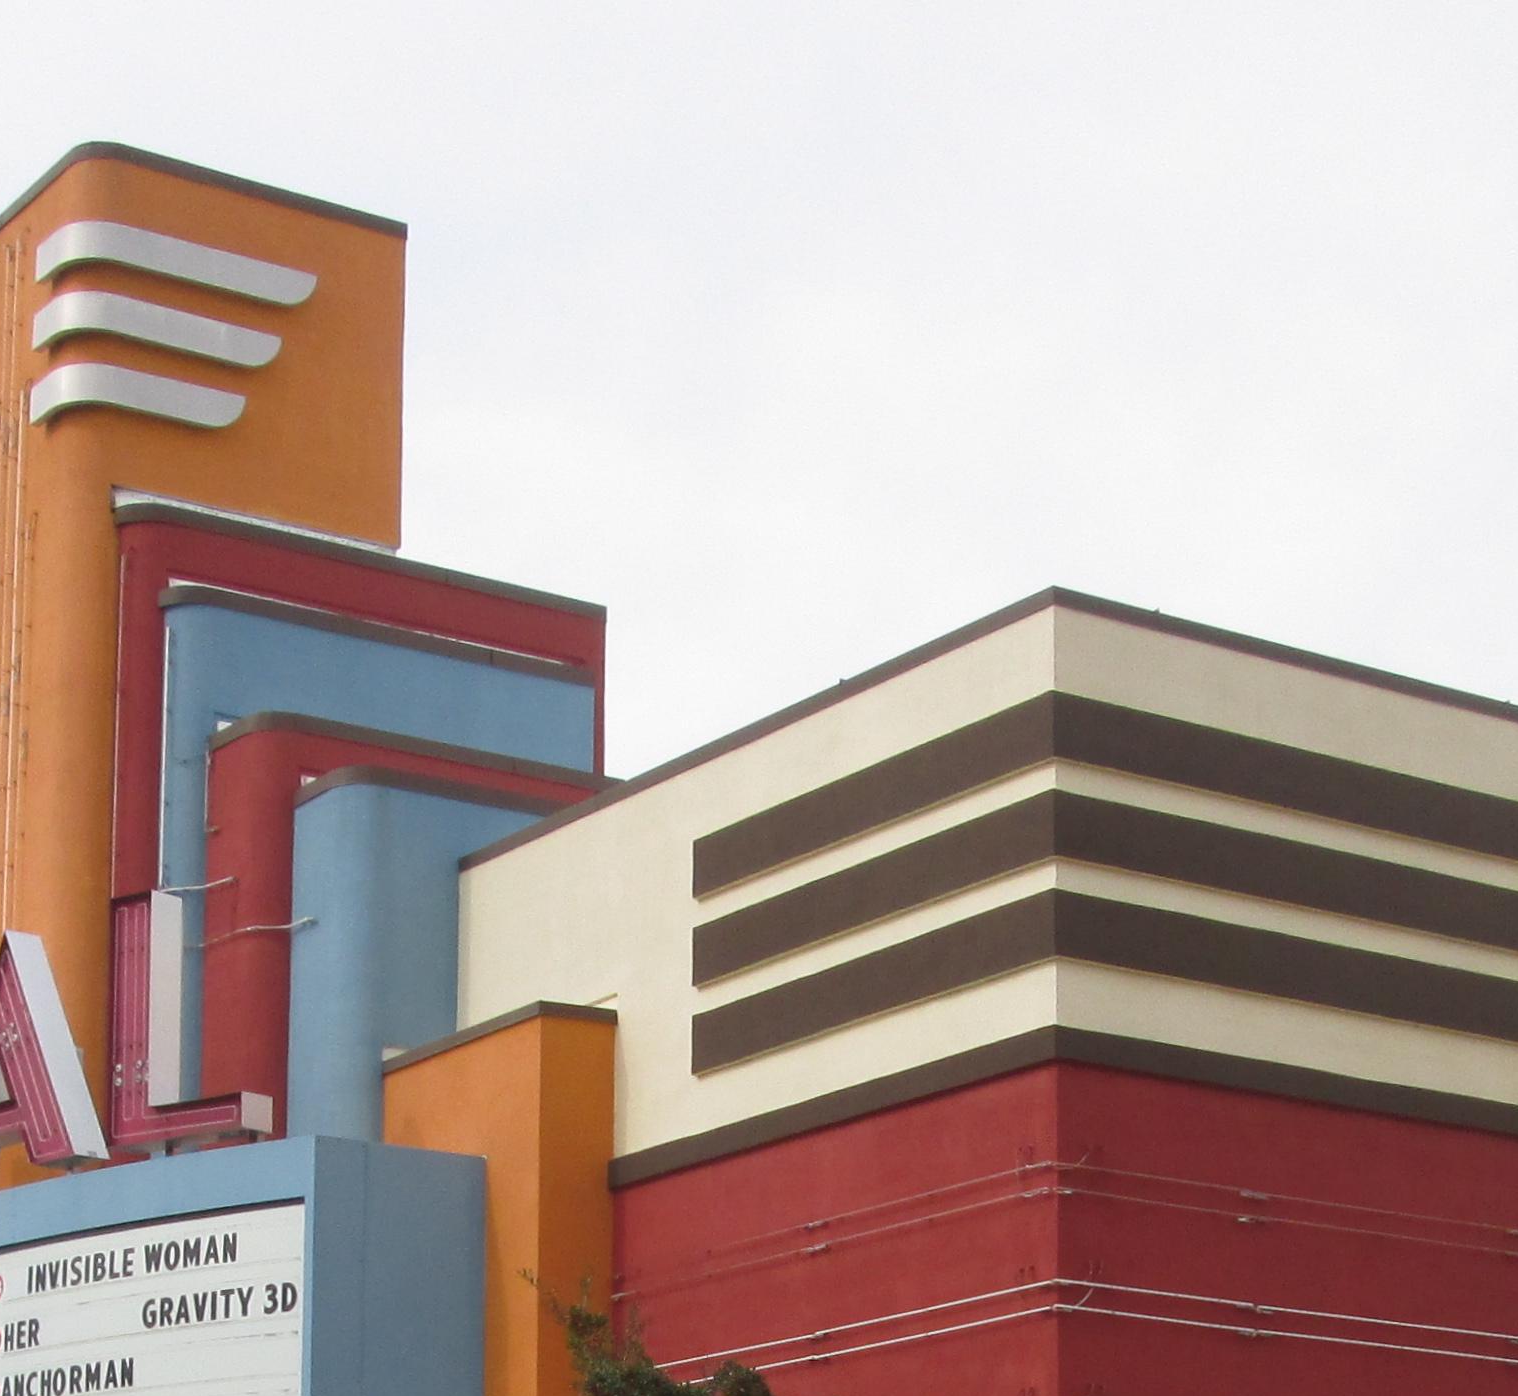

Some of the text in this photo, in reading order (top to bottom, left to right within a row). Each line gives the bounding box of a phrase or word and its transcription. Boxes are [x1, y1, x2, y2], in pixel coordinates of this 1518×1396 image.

[27, 1247, 135, 1295] INVISIBLE
[144, 1232, 238, 1274] WOMAN
[3, 1318, 41, 1351] HER
[141, 1286, 254, 1329] GRAVITY
[263, 1282, 299, 1315] 3D
